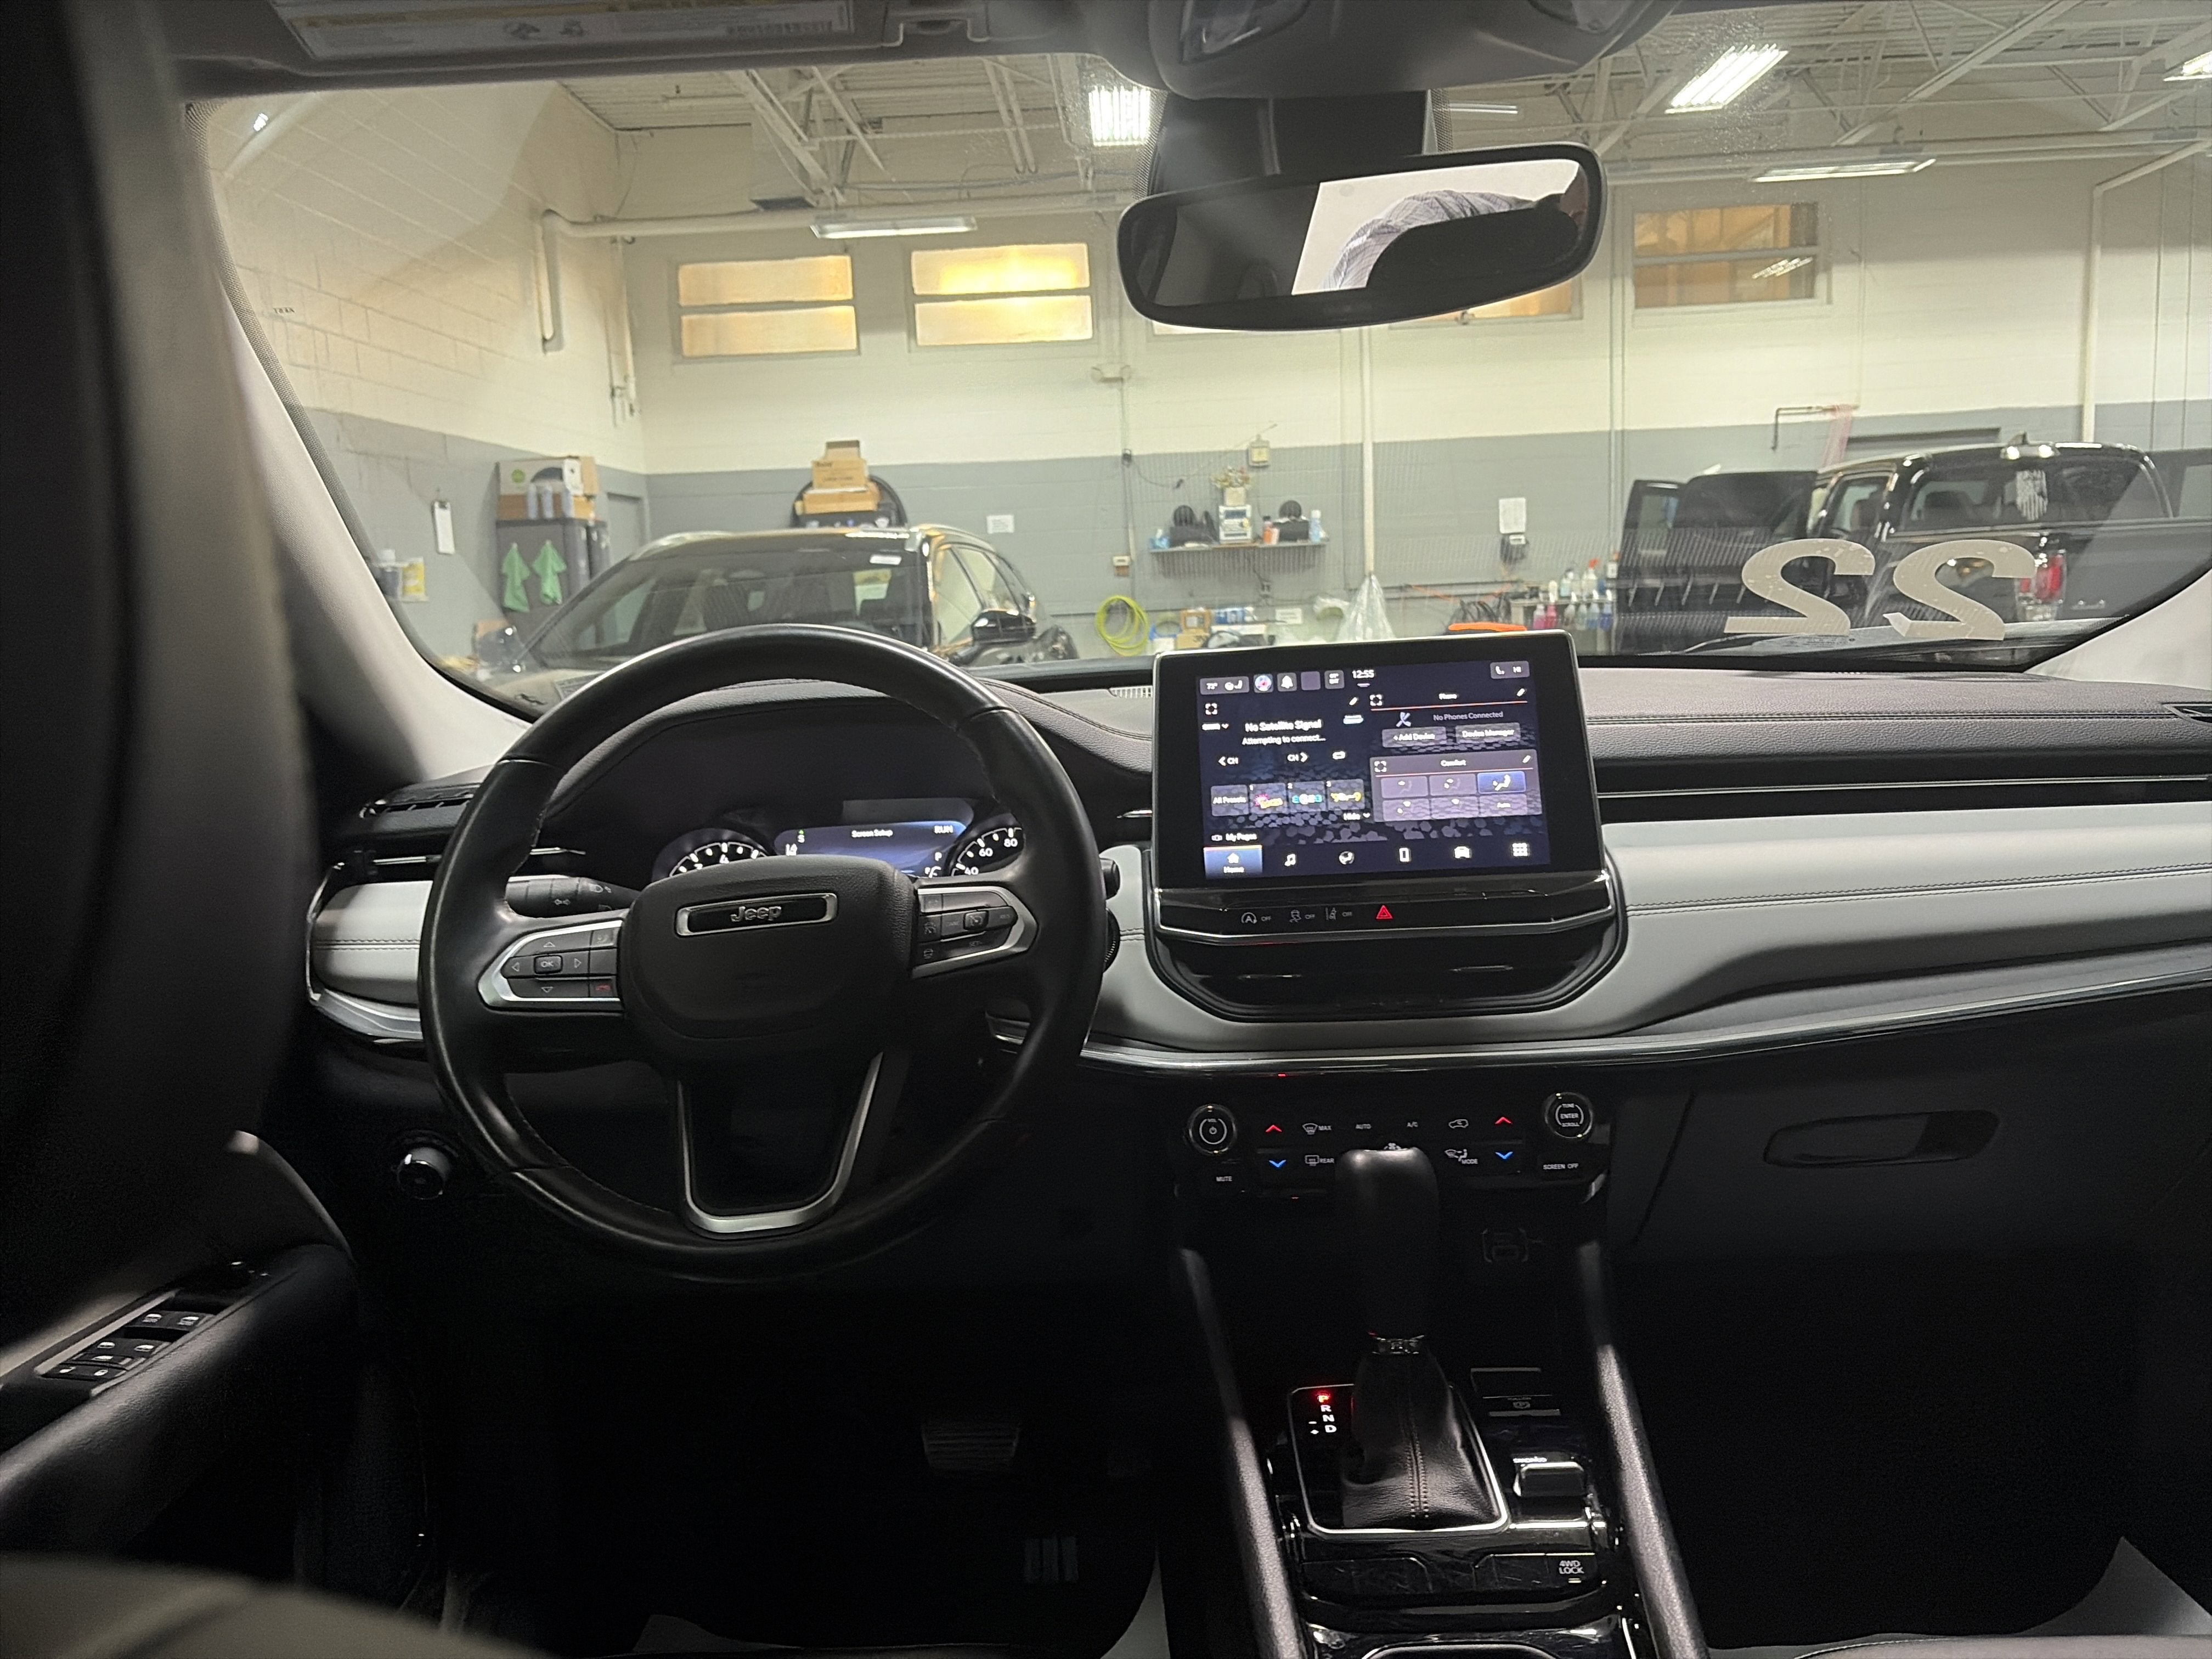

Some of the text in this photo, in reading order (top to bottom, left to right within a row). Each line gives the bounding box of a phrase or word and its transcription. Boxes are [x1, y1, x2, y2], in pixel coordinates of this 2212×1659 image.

[1352, 669, 1374, 679] 12:55
[1443, 712, 1468, 721] Phones
[1468, 710, 1504, 719] Connected
[1245, 719, 1322, 732] No Satellite Signal
[1462, 730, 1485, 738] Device
[1242, 736, 1282, 746] Attempting
[1282, 735, 1290, 743] to
[1227, 757, 1239, 765] CH
[1286, 754, 1299, 762] CH
[934, 825, 953, 833] RUN
[1004, 838, 1018, 847] 80
[935, 852, 942, 861] P
[979, 848, 993, 857] 60
[964, 866, 979, 875] 40
[730, 906, 782, 922] Jeep
[1324, 1425, 1337, 1433] D
